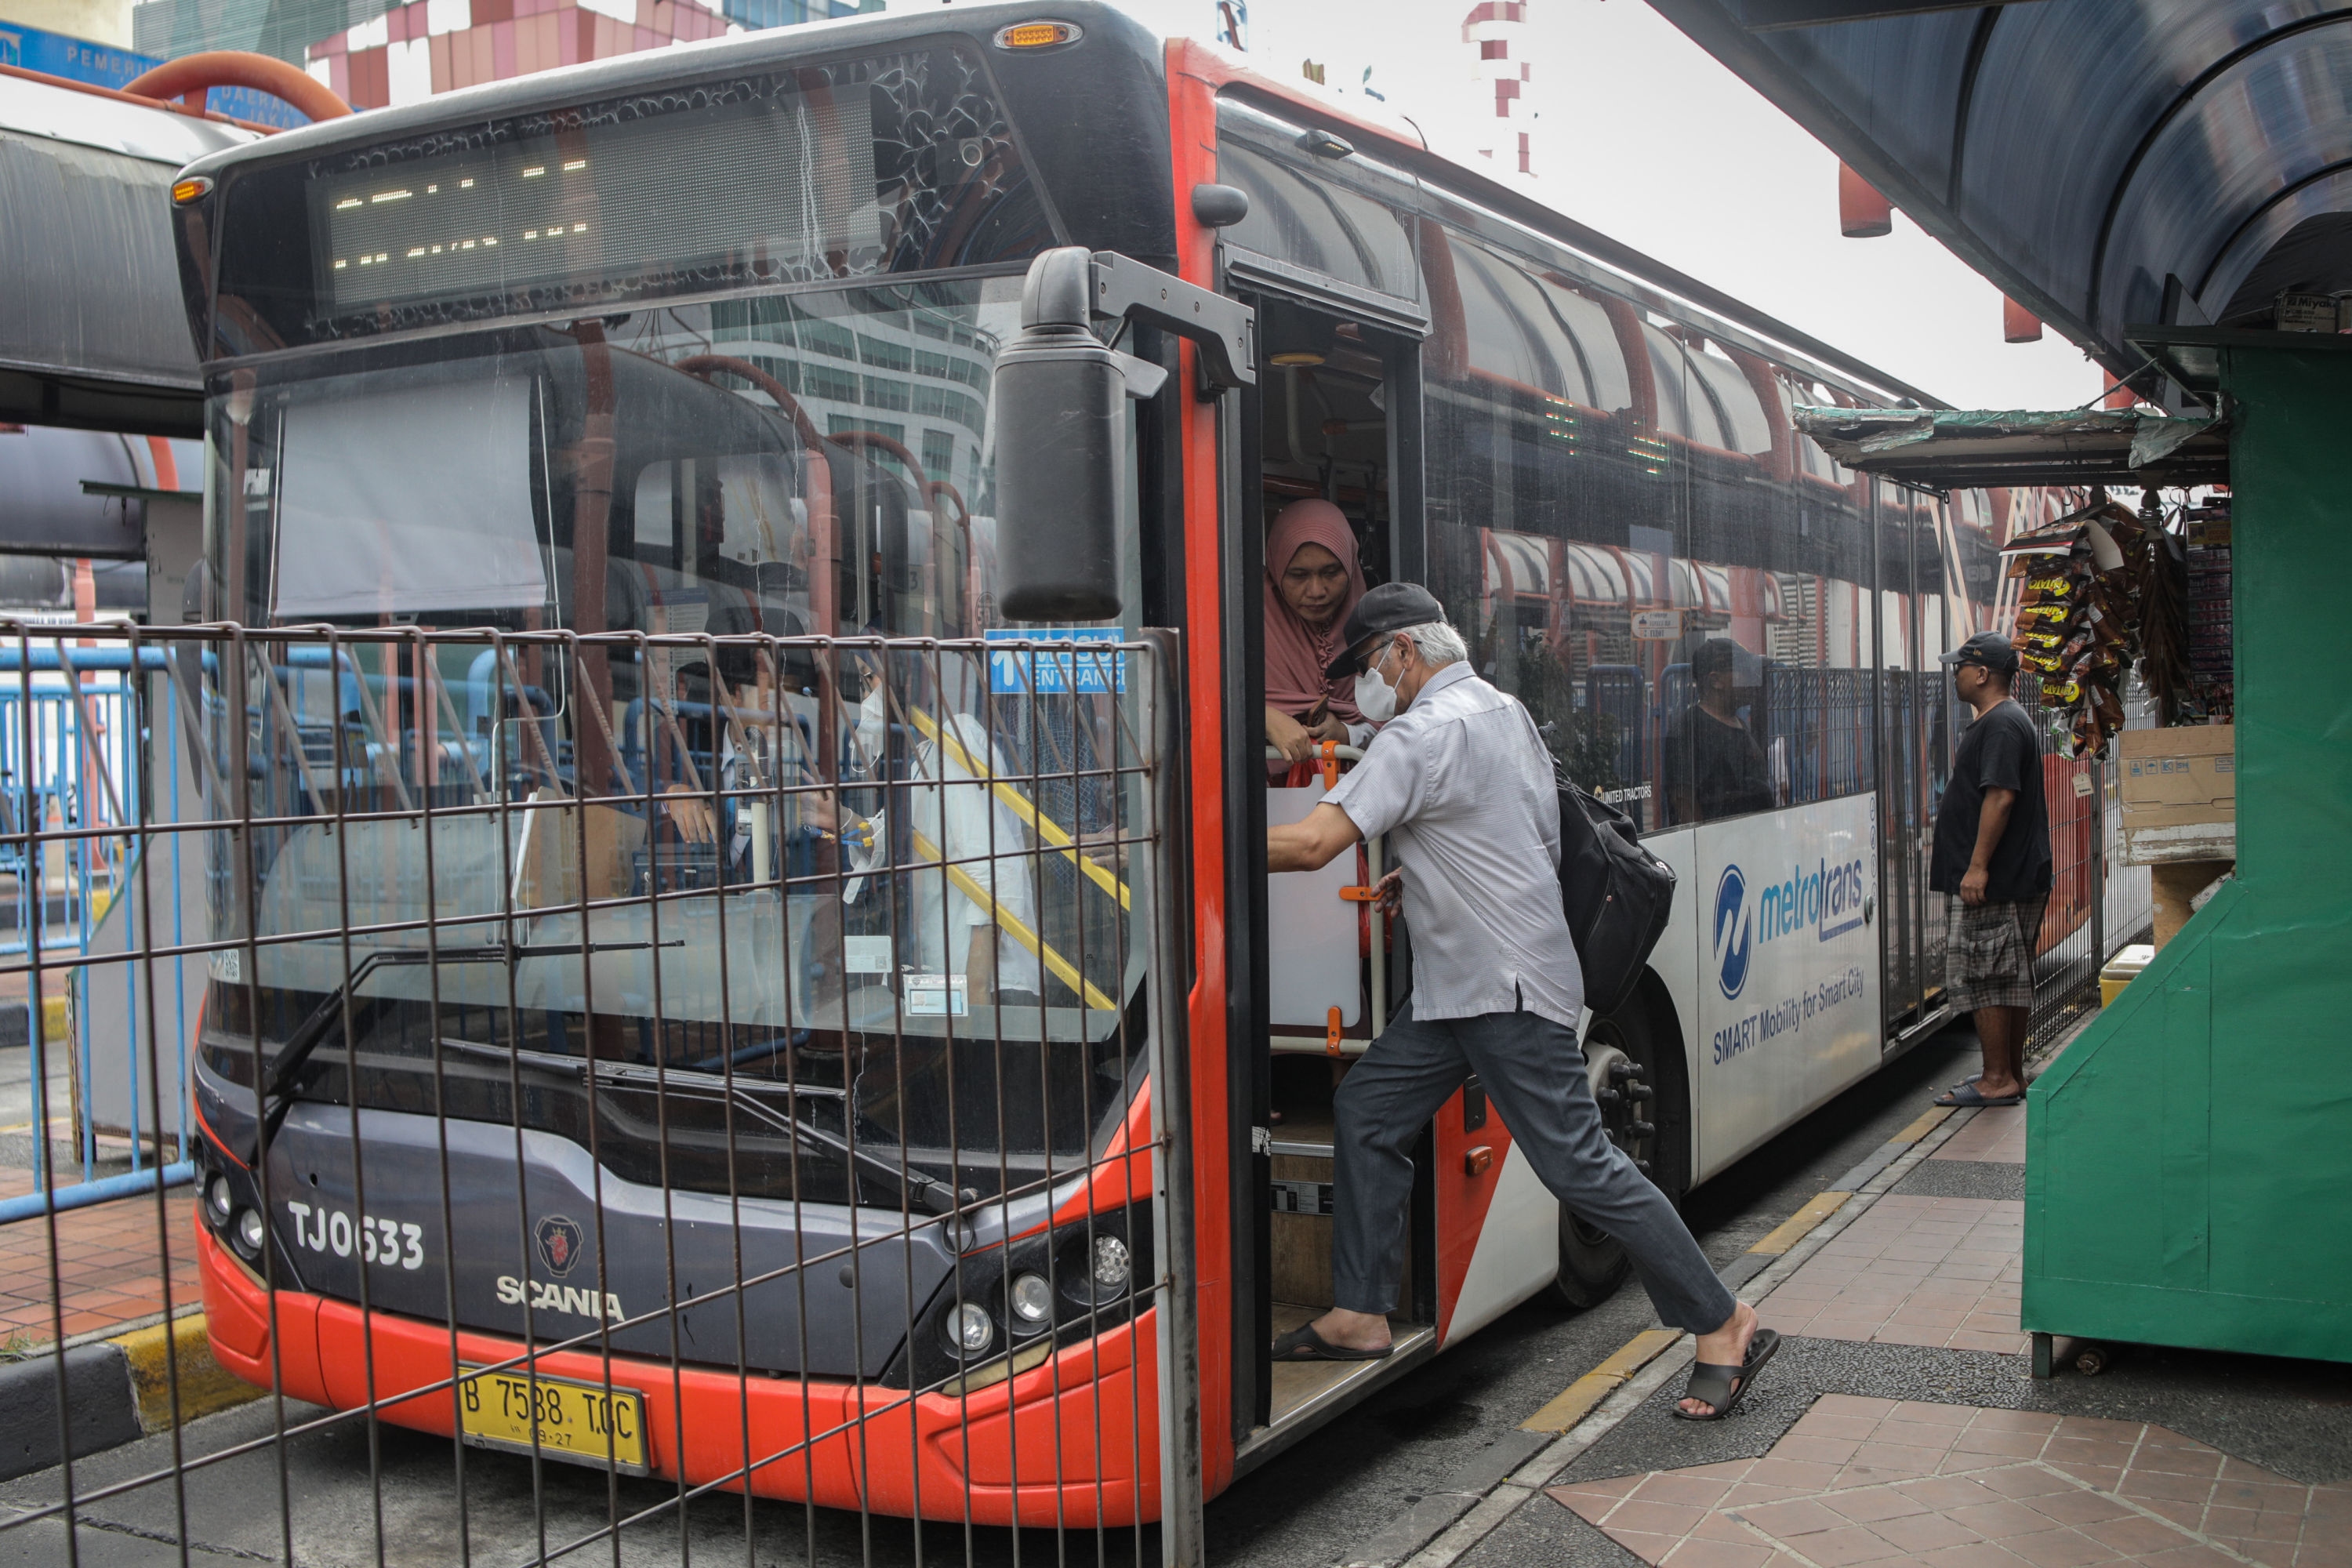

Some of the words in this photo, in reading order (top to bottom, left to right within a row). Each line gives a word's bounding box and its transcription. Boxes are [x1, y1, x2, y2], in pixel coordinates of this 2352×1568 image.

[1624, 785, 1652, 802] TRACTORS
[1759, 857, 1863, 944] metrotrans
[1713, 1014, 1758, 1065] SMART
[1760, 998, 1802, 1043] Mobility
[1802, 990, 1817, 1021] for
[1819, 978, 1846, 1012] Smart
[1848, 966, 1864, 999] City
[288, 1200, 424, 1270] TJ0633
[496, 1276, 626, 1323] SCANIA
[464, 1377, 480, 1412] B
